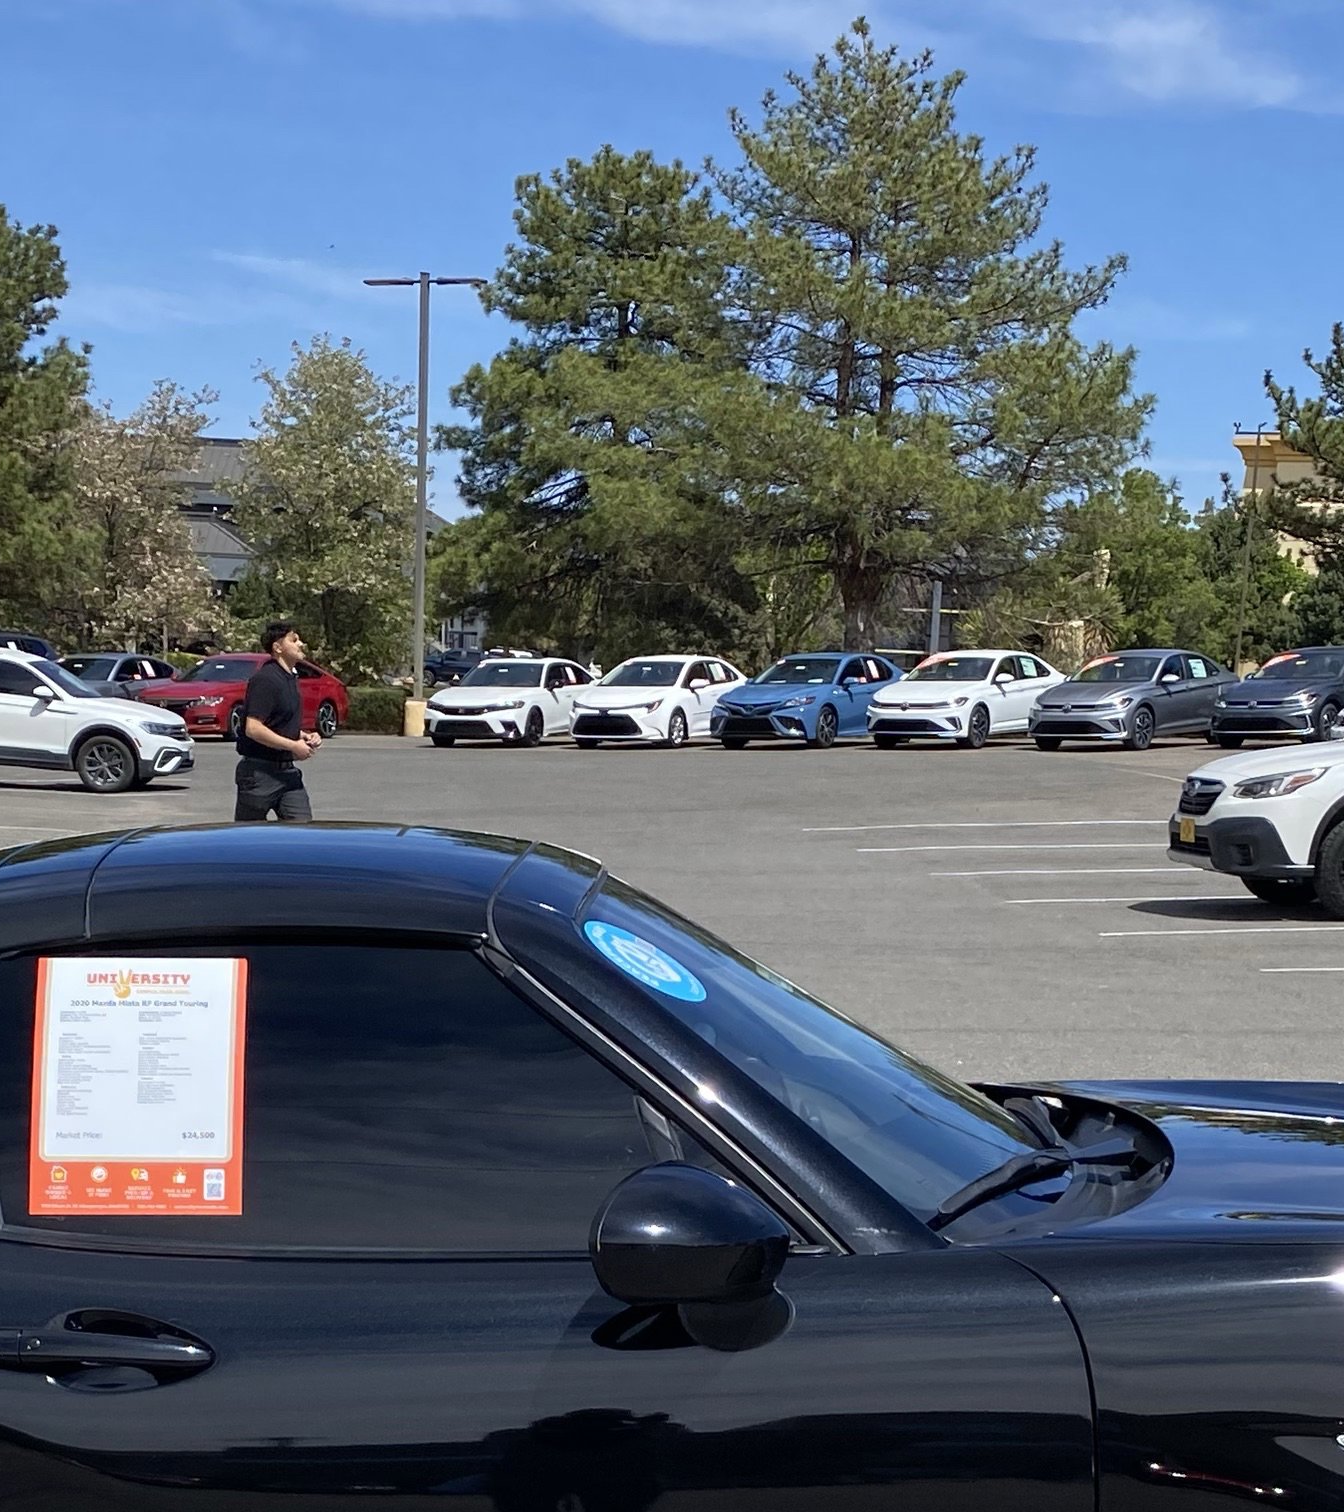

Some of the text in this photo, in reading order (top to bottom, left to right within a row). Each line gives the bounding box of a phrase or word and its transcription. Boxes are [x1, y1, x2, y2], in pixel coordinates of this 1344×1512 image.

[70, 999, 90, 1008] 2020
[154, 999, 177, 1008] Grand
[179, 999, 209, 1009] Touring
